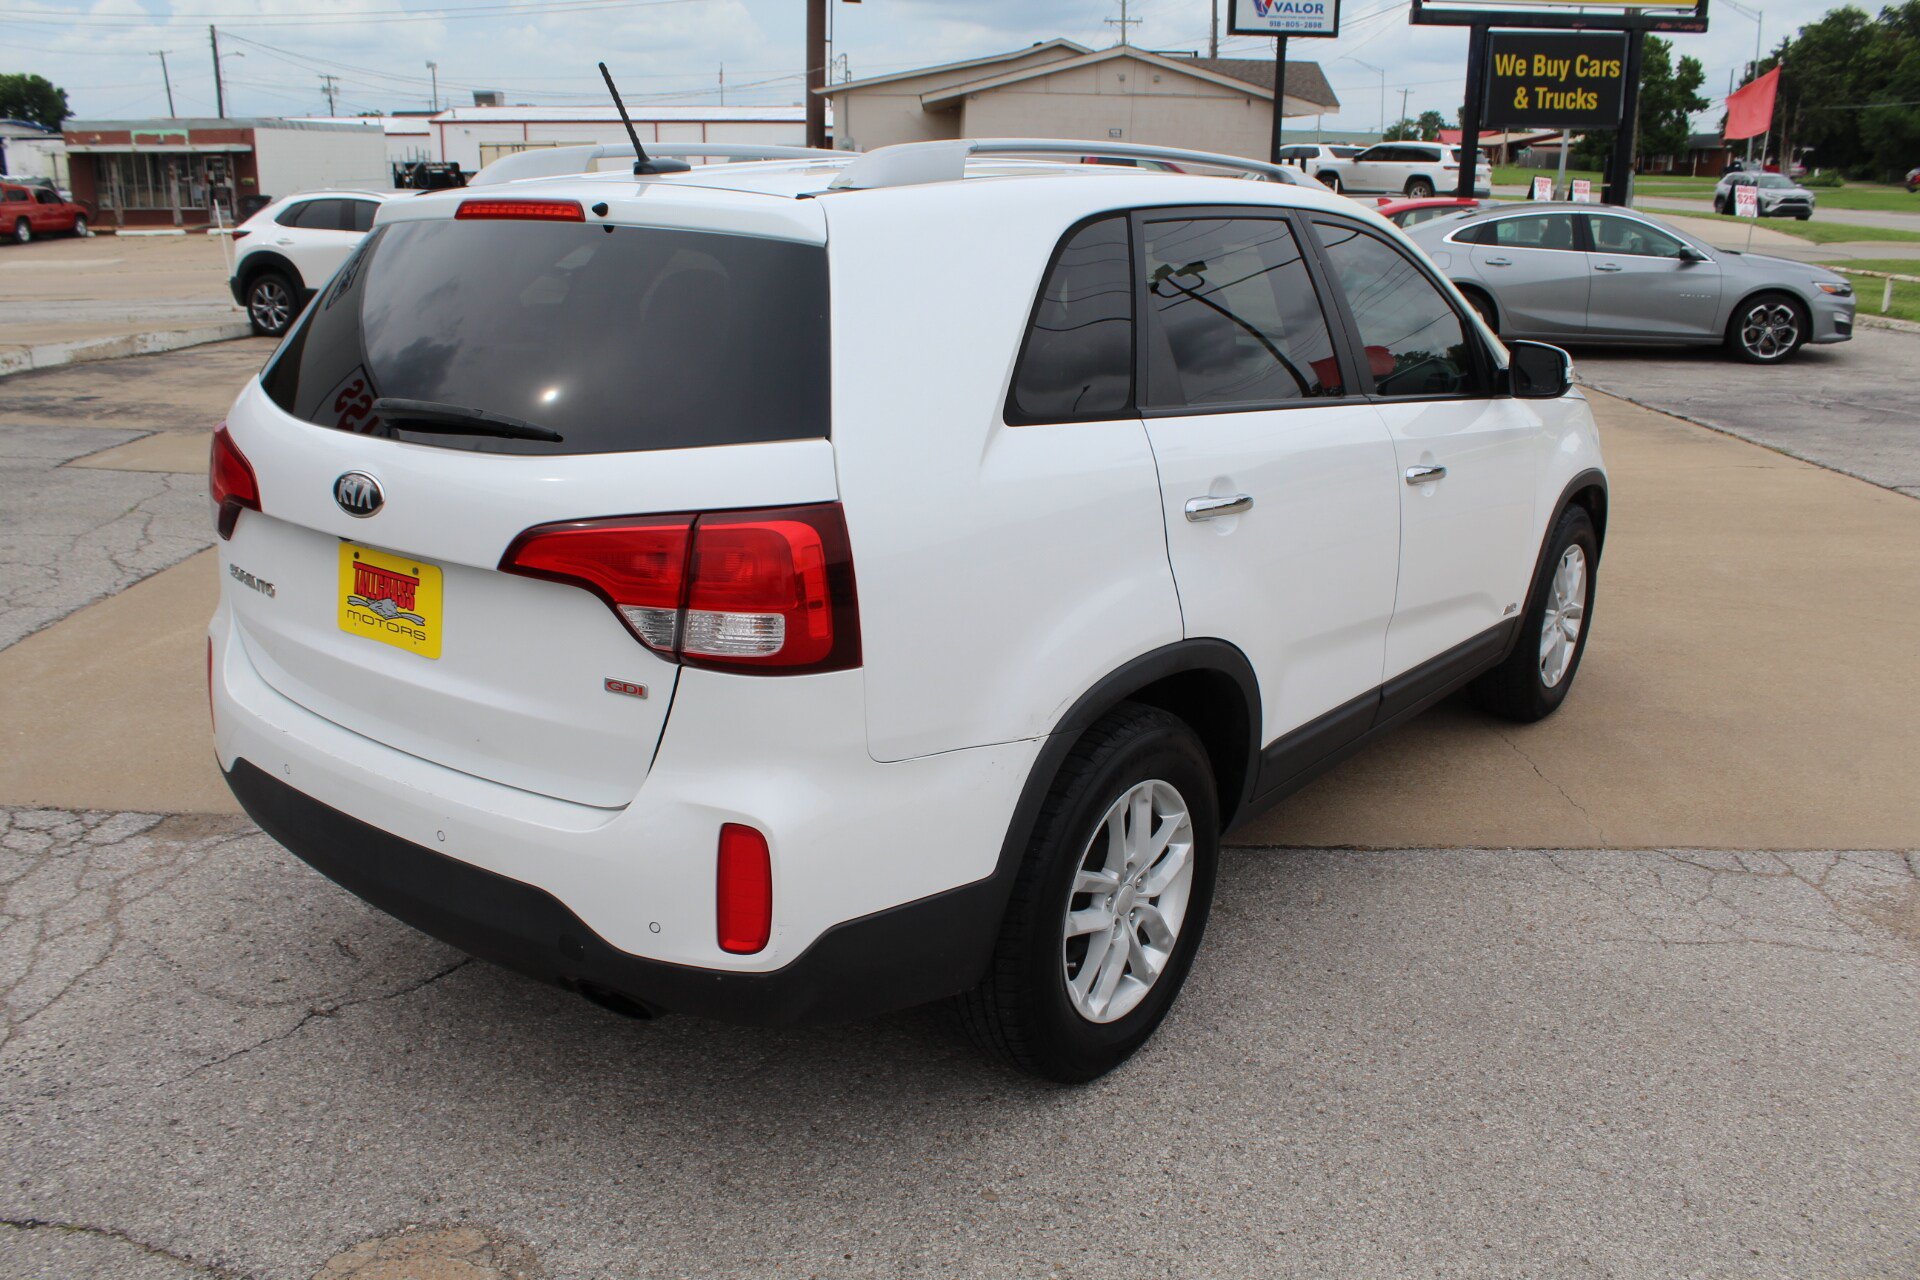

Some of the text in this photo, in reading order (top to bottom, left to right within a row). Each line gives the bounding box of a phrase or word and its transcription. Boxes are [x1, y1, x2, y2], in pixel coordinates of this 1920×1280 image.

[1273, 2, 1325, 14] VALOR
[1269, 20, 1323, 29] 918-805-2898
[1494, 53, 1621, 82] We Buy Cars
[1513, 86, 1598, 110] & Trucks
[1736, 193, 1757, 205] $25
[338, 478, 373, 510] KIA
[352, 560, 420, 612] TALLGRASS
[346, 608, 427, 641] MOTORS
[606, 681, 643, 696] GDI
